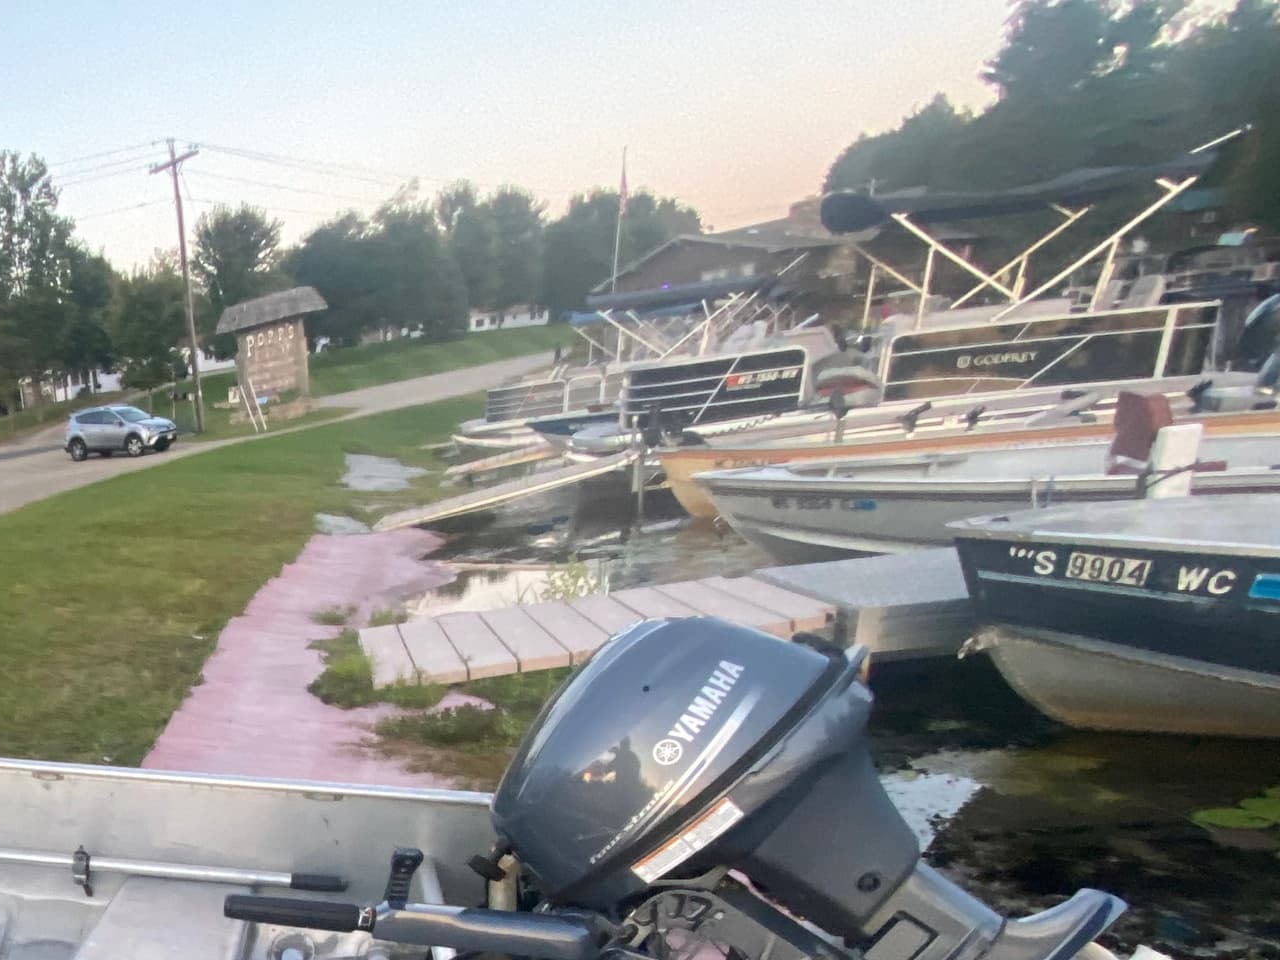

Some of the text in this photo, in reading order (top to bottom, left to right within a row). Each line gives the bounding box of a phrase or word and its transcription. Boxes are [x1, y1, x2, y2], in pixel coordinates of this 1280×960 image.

[1070, 554, 1151, 586] 9904
[1177, 565, 1237, 595] WC
[668, 659, 745, 743] YAMAHA
